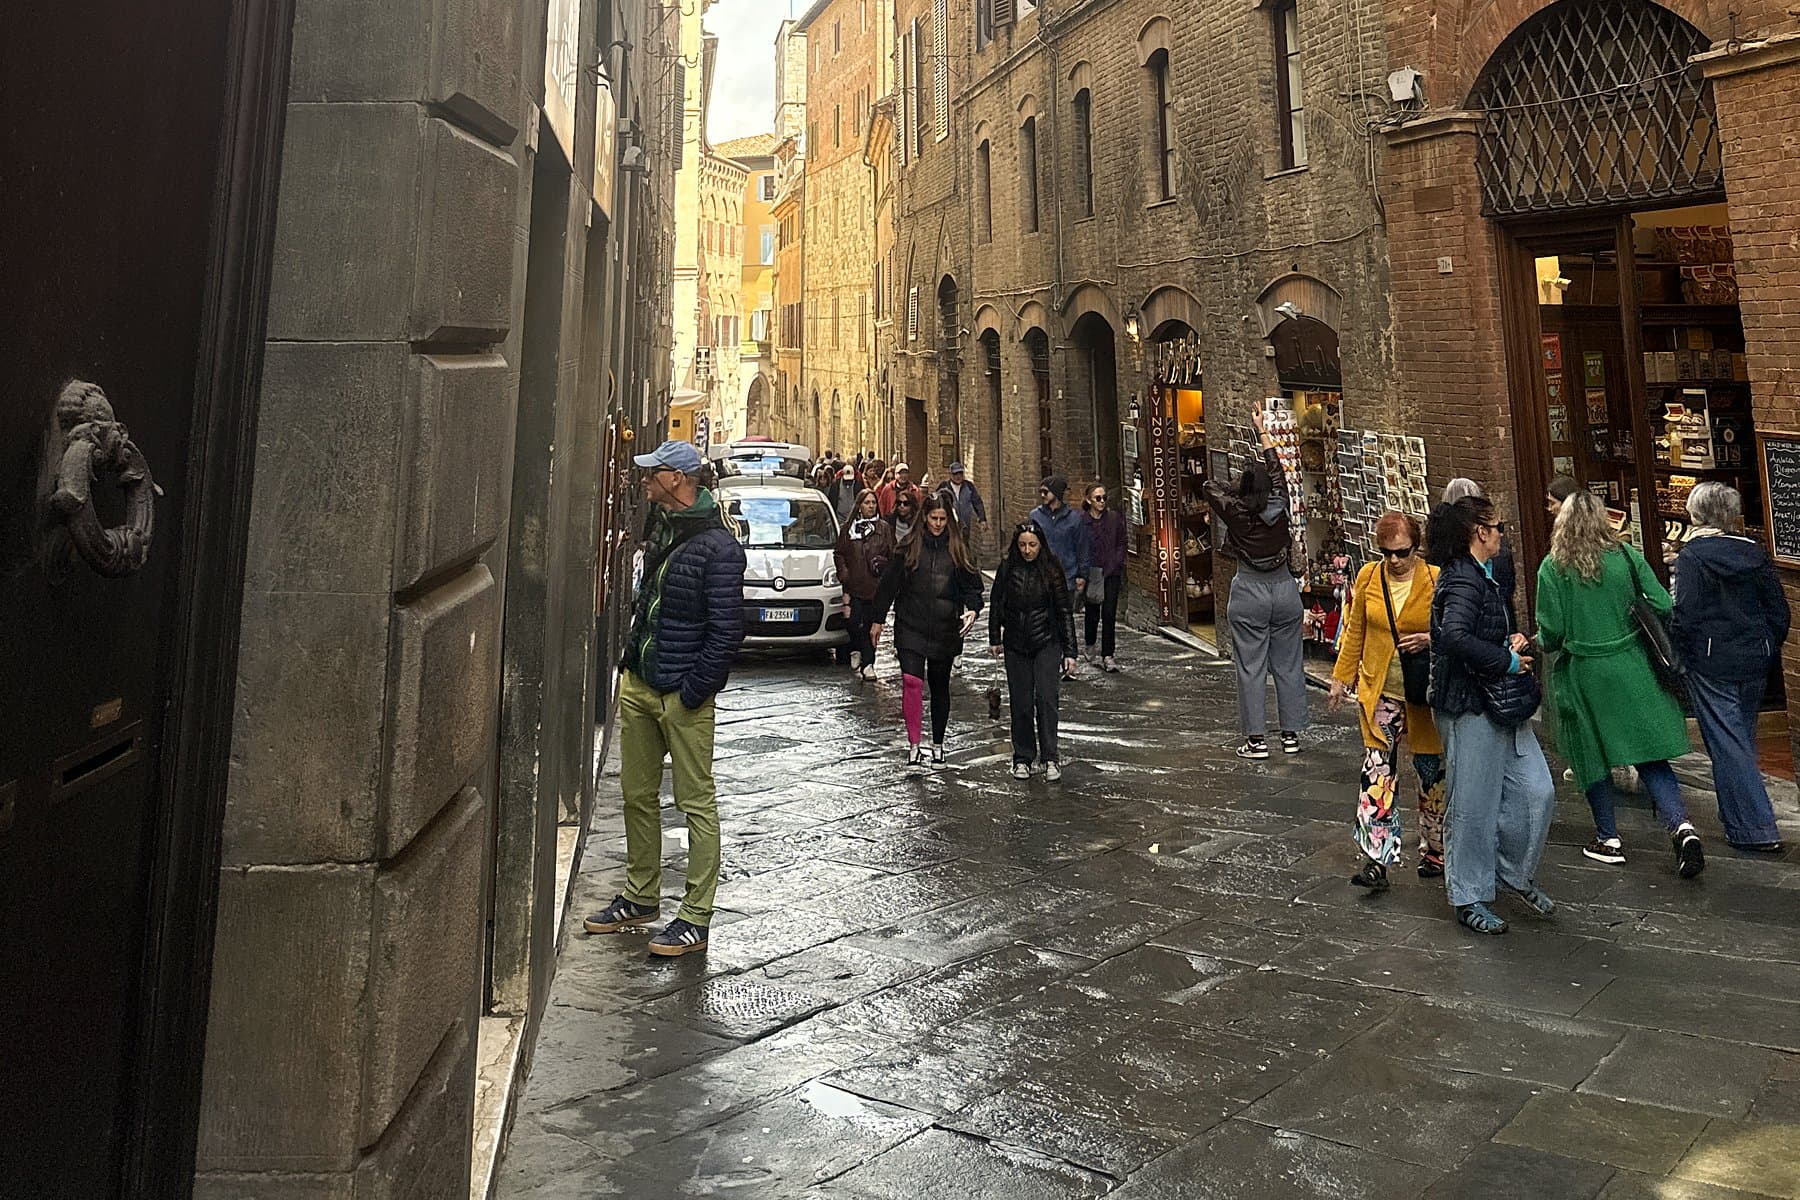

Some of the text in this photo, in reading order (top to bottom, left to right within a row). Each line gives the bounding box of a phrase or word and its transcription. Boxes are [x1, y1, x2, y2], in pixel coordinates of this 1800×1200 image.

[1151, 396, 1169, 603] VINO PRODOTTI LOCALI
